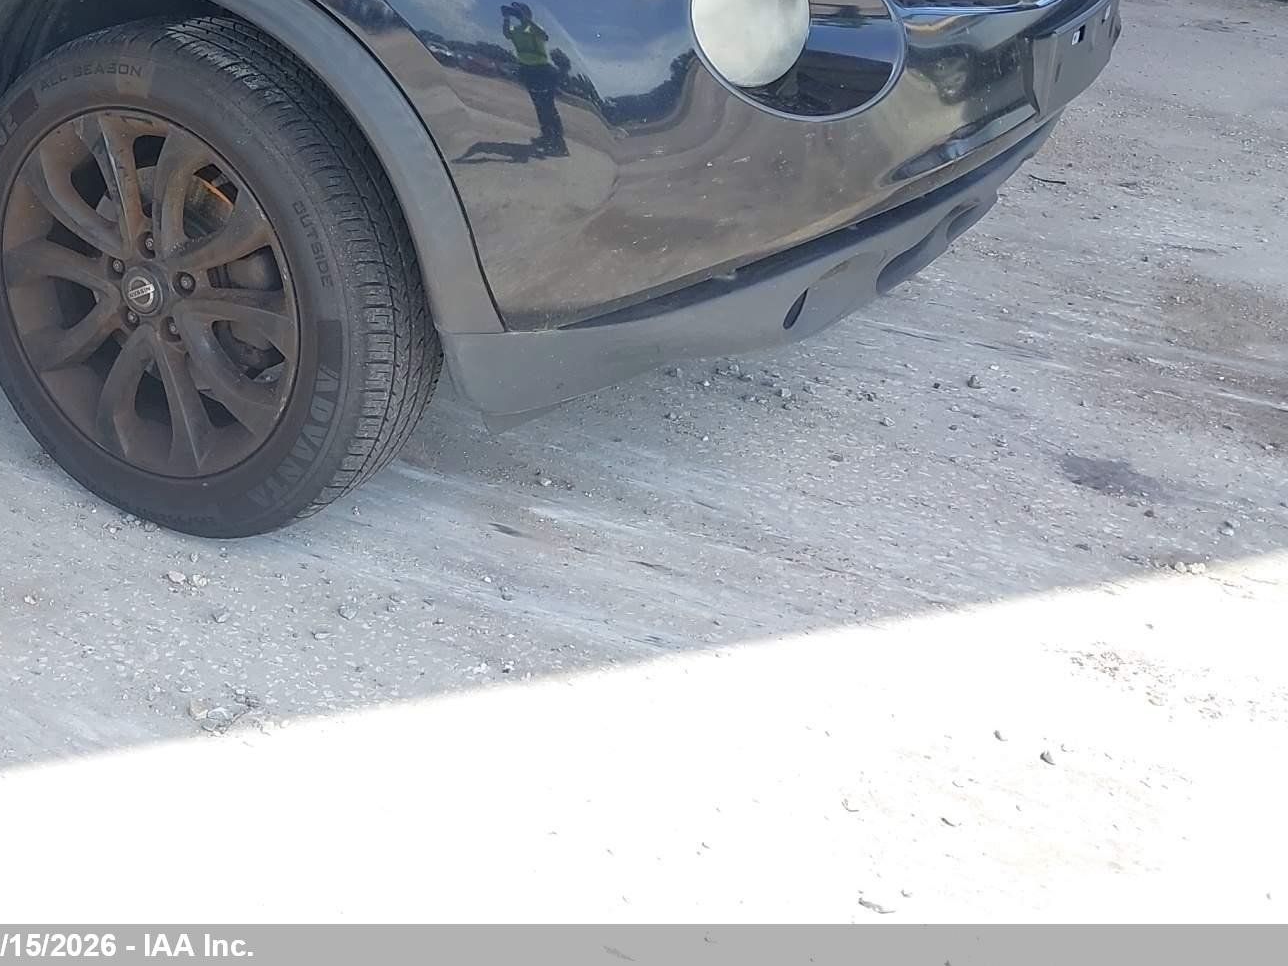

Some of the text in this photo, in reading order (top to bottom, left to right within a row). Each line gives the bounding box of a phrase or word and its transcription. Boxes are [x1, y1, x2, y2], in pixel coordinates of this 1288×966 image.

[73, 63, 144, 78] SEASON
[292, 200, 335, 288] OUTSIDE
[247, 366, 341, 512] ADVANTA
